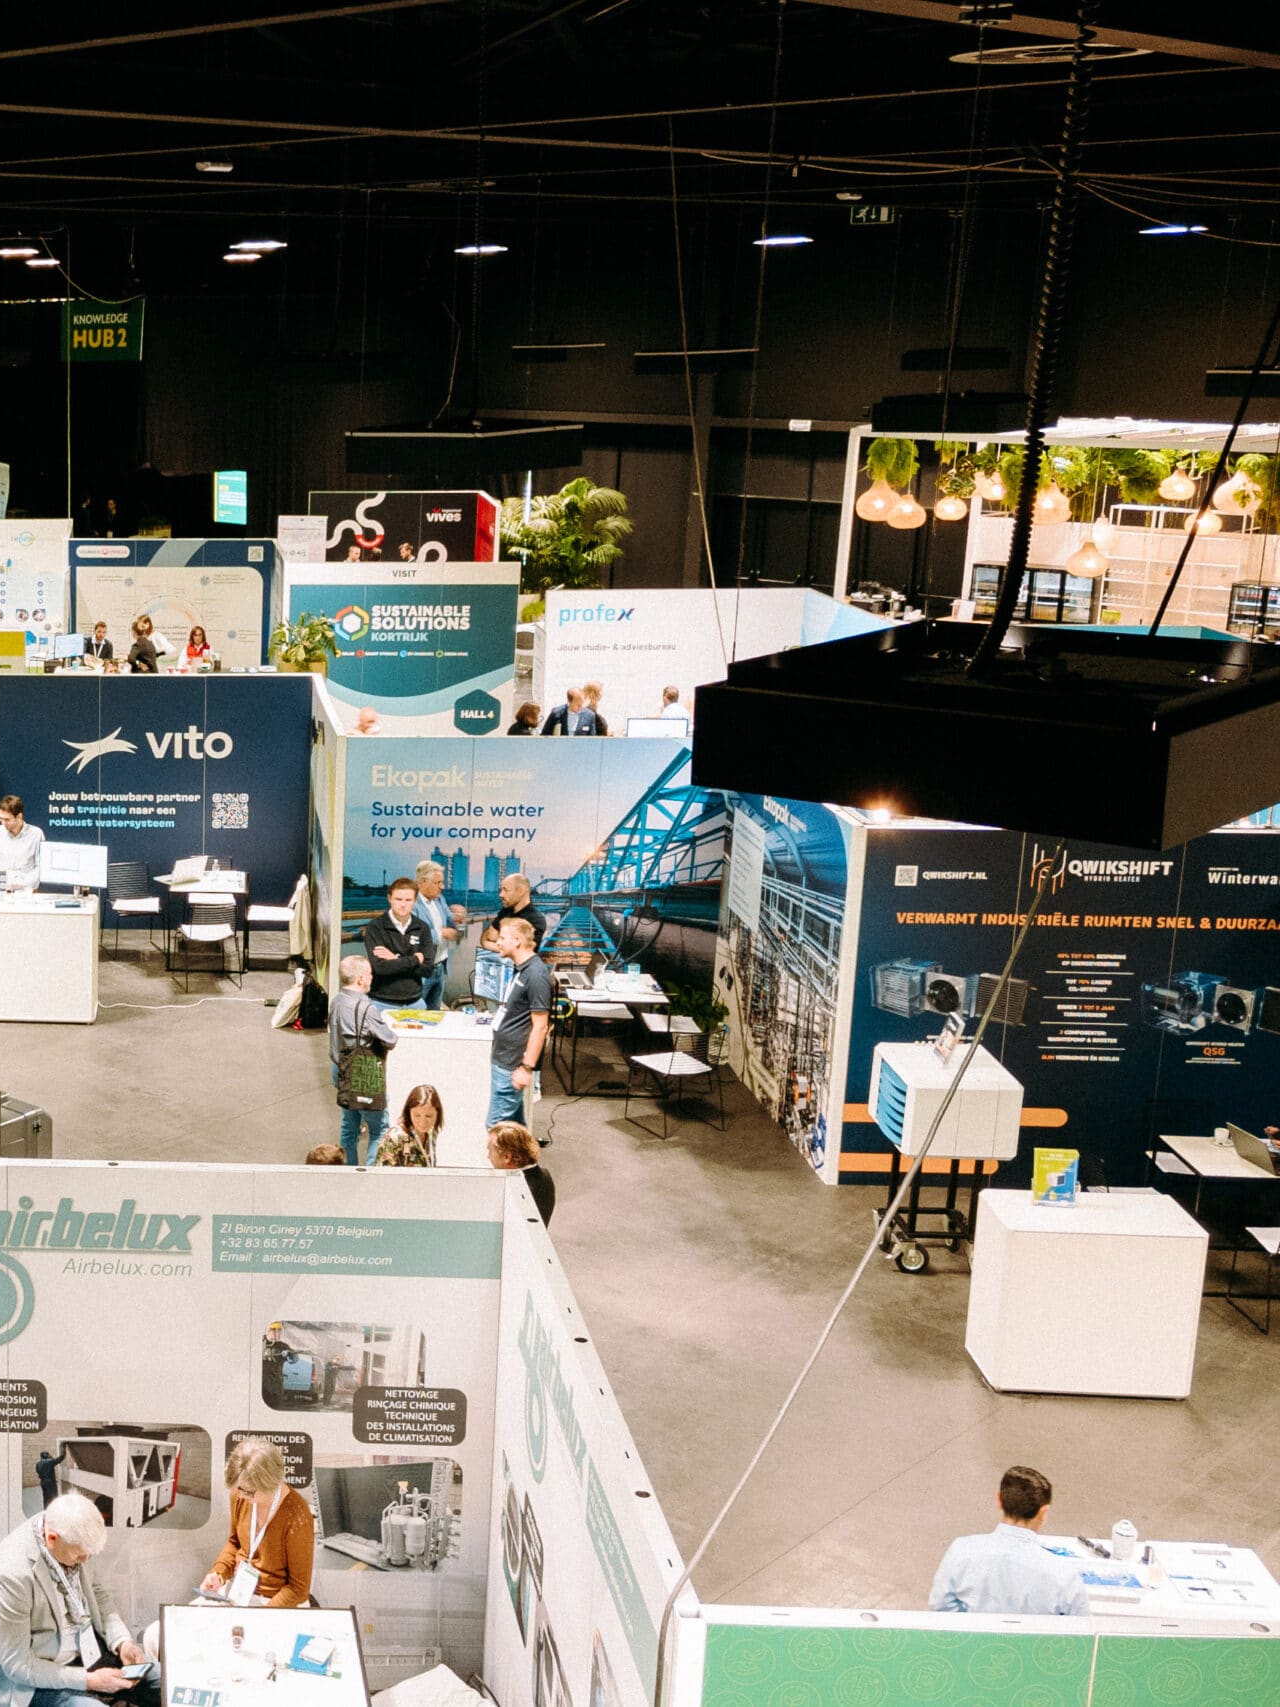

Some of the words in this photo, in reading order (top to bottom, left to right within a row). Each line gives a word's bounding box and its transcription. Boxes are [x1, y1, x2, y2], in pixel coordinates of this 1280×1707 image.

[73, 313, 128, 325] KNOWLEDGE
[73, 329, 115, 349] HUB
[117, 328, 127, 348] 2
[426, 512, 462, 523] vives
[392, 570, 417, 578] VISIT
[371, 605, 470, 617] SUSTAINABLE
[559, 603, 635, 626] profex
[371, 617, 471, 631] SOLUTIONS
[371, 632, 429, 642] KORTRIJK
[460, 709, 486, 719] HALL
[486, 709, 495, 719] 4
[145, 725, 234, 760] vito
[371, 764, 466, 793] Ekopak
[48, 792, 78, 801] Jouw
[80, 791, 154, 802] betrouwbare
[156, 793, 201, 803] partner
[48, 805, 59, 814] in
[61, 805, 75, 814] de
[77, 804, 127, 815] transitie
[129, 807, 155, 815] naar
[156, 807, 176, 815] een
[371, 801, 484, 817] Sustainable
[490, 803, 544, 817] water
[48, 818, 93, 827] robuust
[95, 819, 175, 830] watersysteem
[370, 823, 396, 838] for
[401, 826, 443, 841] your
[447, 827, 537, 842] company
[1068, 859, 1174, 877] QWIKSHIFT
[922, 871, 988, 880] QWIKSHIFT.NL
[1208, 871, 1280, 885] Winterwa
[896, 912, 978, 926] VERWARMT
[981, 911, 1080, 927] INDUSRIËLE
[1083, 915, 1153, 928] RUIMTEN
[1156, 916, 1194, 929] SNEL
[1200, 917, 1211, 929] &
[1203, 1047, 1226, 1056] QSG
[219, 1223, 232, 1234] ZI
[235, 1223, 266, 1235] Biron
[269, 1225, 301, 1237] Ciney
[305, 1225, 334, 1236] 5370
[337, 1226, 384, 1239] Belgium
[220, 1238, 241, 1248] +32
[219, 1251, 252, 1262] Email
[262, 1252, 393, 1267] airbelux@airbelux.com
[62, 1257, 193, 1277] Airbelux.com
[385, 1389, 439, 1400] NETTOYAGE
[367, 1400, 407, 1411] RINÇAGE
[409, 1401, 456, 1412] CHIMIQUE
[384, 1411, 438, 1422] TECHNIQUE
[366, 1421, 384, 1431] DES
[385, 1422, 456, 1433] INSTALLATIONS
[289, 1435, 306, 1444] DES
[368, 1432, 381, 1441] DE
[383, 1433, 453, 1444] CLIMATISATION
